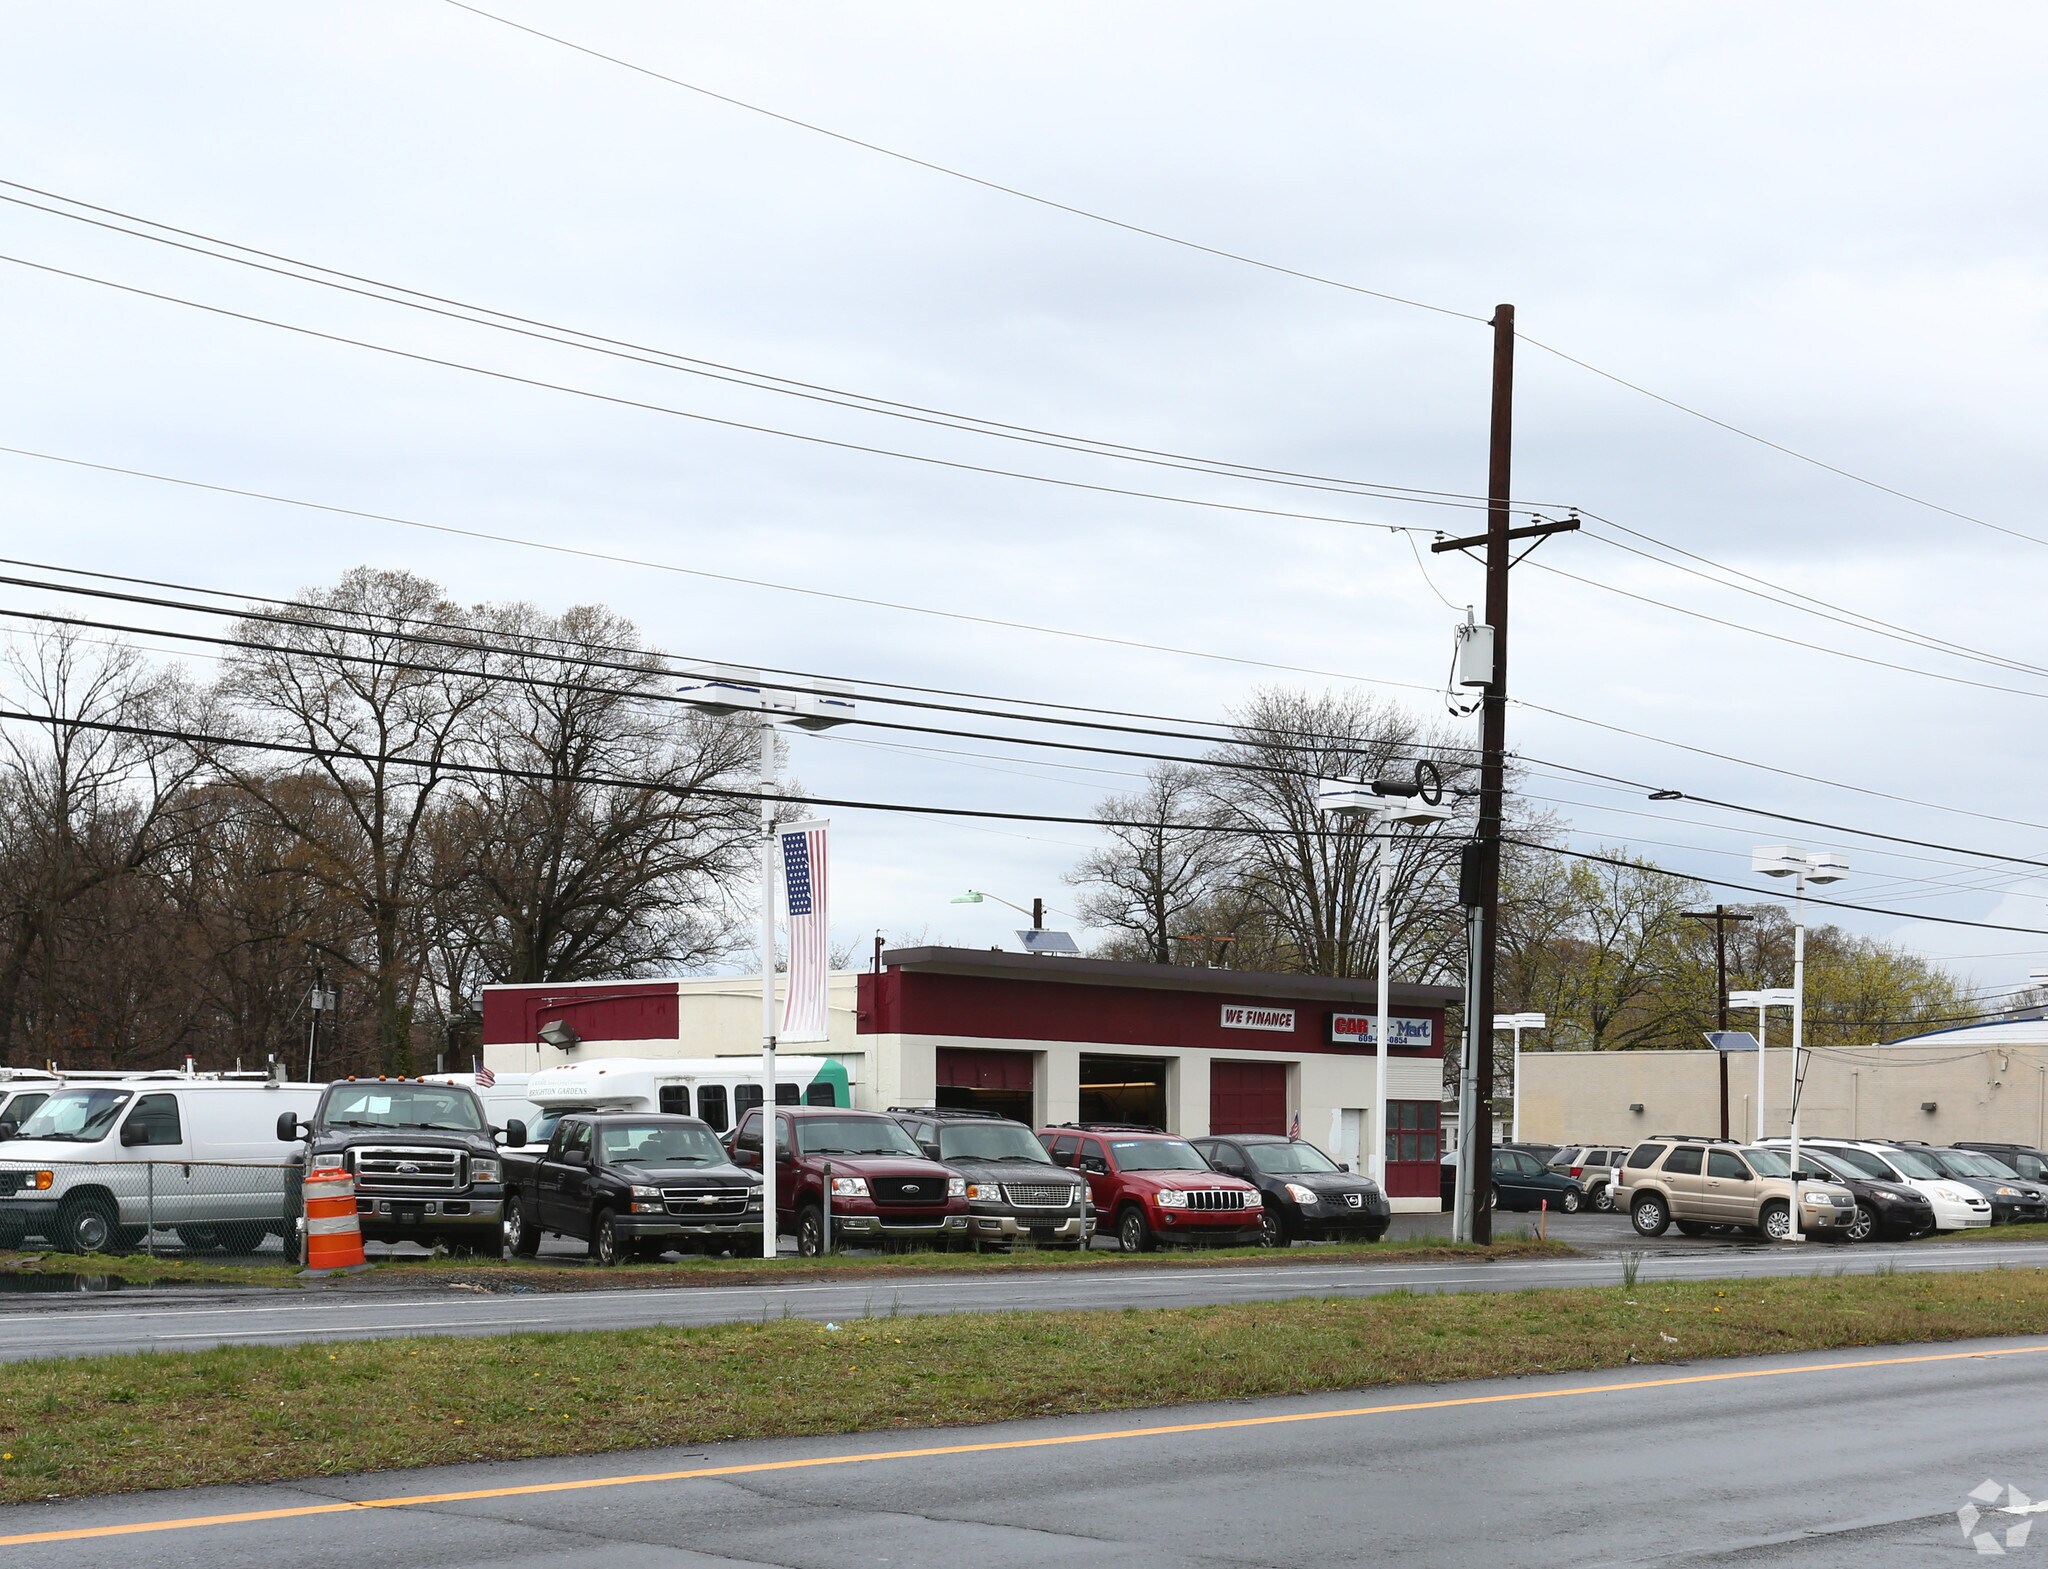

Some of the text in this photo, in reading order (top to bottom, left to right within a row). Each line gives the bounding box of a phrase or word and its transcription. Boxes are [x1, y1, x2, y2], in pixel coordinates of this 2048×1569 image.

[1225, 1009, 1293, 1028] WE FINANCE
[1334, 1017, 1369, 1035] CAR
[1396, 1020, 1431, 1038] Mart
[1358, 1034, 1408, 1044] 609--0854
[529, 1087, 588, 1097] BRIGHTON GARDENS
